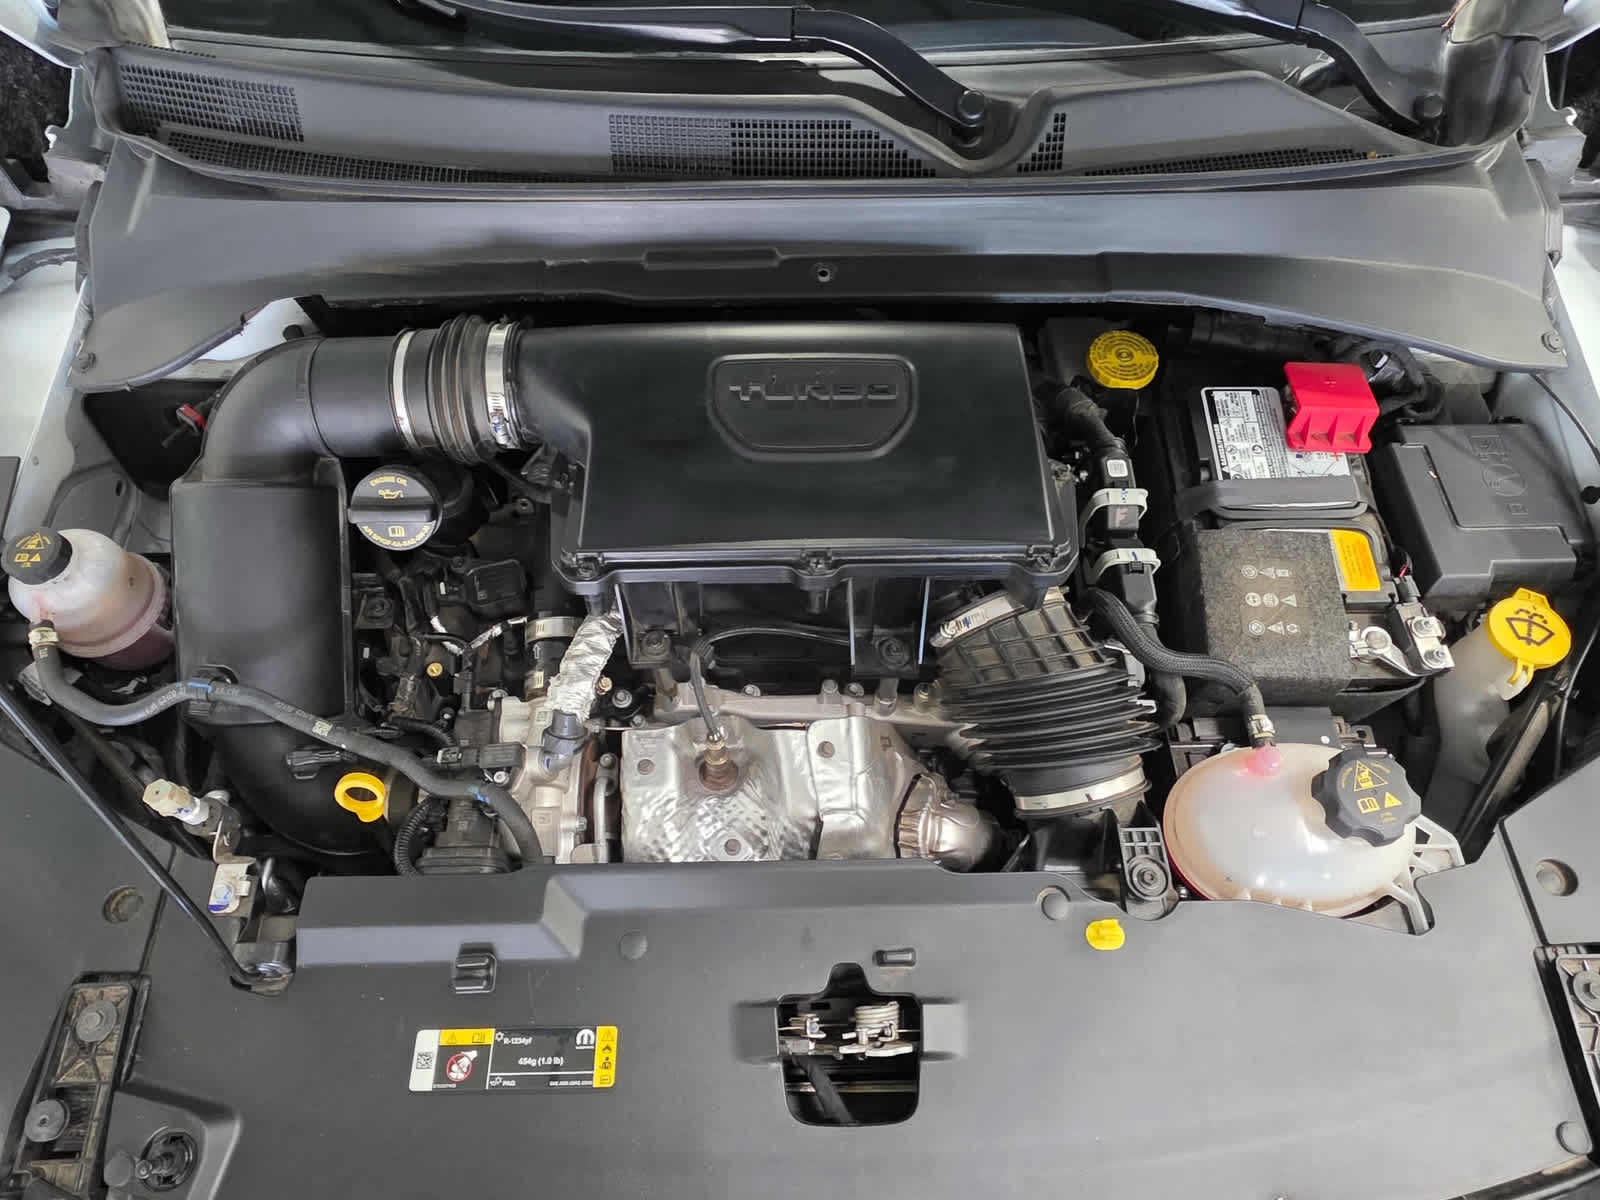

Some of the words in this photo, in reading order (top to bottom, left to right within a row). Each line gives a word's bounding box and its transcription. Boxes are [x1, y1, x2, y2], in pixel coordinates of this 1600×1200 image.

[728, 384, 898, 402] TURBO
[370, 475, 395, 486] ENGINE
[396, 476, 408, 486] OIL
[503, 1036, 533, 1046] R-1234yf
[518, 1057, 536, 1067] 454g
[537, 1056, 552, 1067] (1.0
[553, 1056, 564, 1066] lb)
